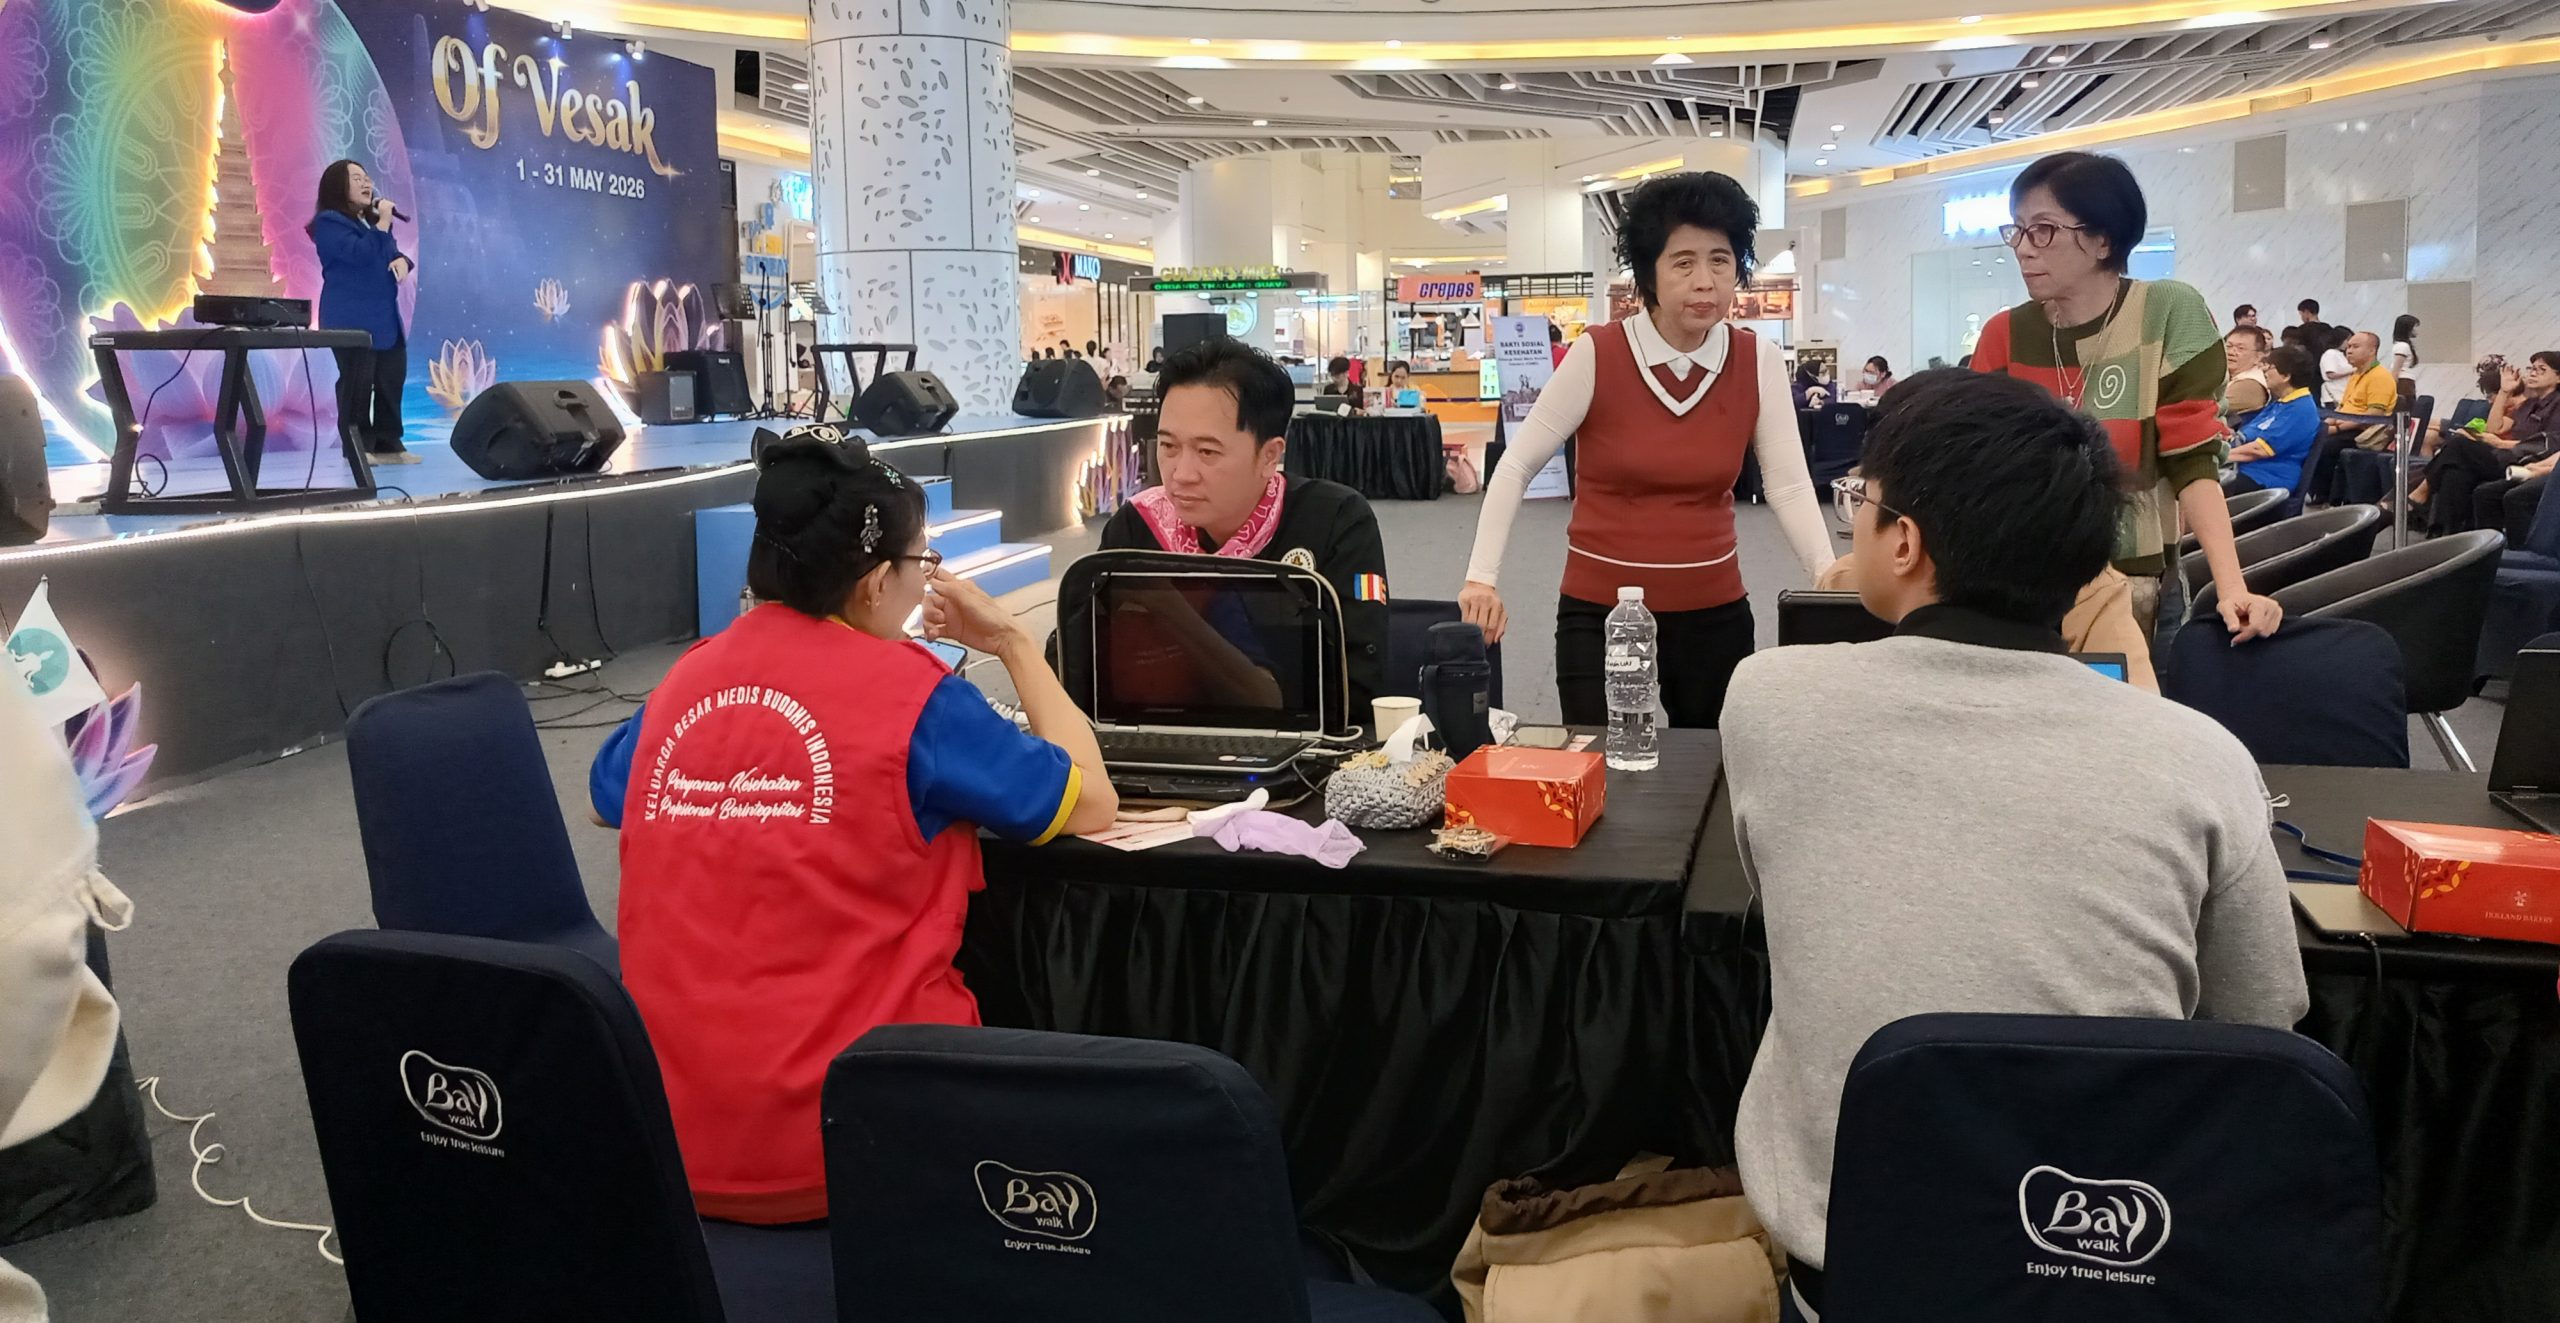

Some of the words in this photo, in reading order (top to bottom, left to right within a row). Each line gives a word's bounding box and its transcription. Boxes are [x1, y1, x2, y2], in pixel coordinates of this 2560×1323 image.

[432, 35, 508, 149] Of
[513, 54, 680, 176] Vesak
[516, 159, 526, 181] 1
[544, 163, 564, 187] 31
[570, 166, 604, 193] MAY
[608, 174, 645, 199] 2026
[1074, 254, 1101, 283] MAKO
[1419, 282, 1474, 300] crepes
[645, 736, 676, 821] KELUARGA
[674, 696, 713, 739] BESAR
[716, 685, 760, 708] MEDIS
[762, 687, 816, 735] BUDDHIS
[804, 732, 834, 824] INDONESIA
[664, 768, 725, 798] Pelayanan
[728, 767, 803, 793] Kesehatan
[719, 797, 805, 823] Berintegritas
[448, 1114, 477, 1128] walk
[421, 1131, 448, 1147] Enjoy
[451, 1137, 470, 1151] true
[471, 1142, 505, 1158] leisure
[1035, 1217, 1064, 1229] walk
[1004, 1239, 1031, 1251] Enjoy
[1035, 1241, 1057, 1251] true
[1059, 1244, 1091, 1255] leisure
[2077, 1238, 2120, 1253] walk
[2026, 1262, 2068, 1279] Enjoy
[2071, 1265, 2103, 1280] true
[2105, 1269, 2157, 1285] leisure
